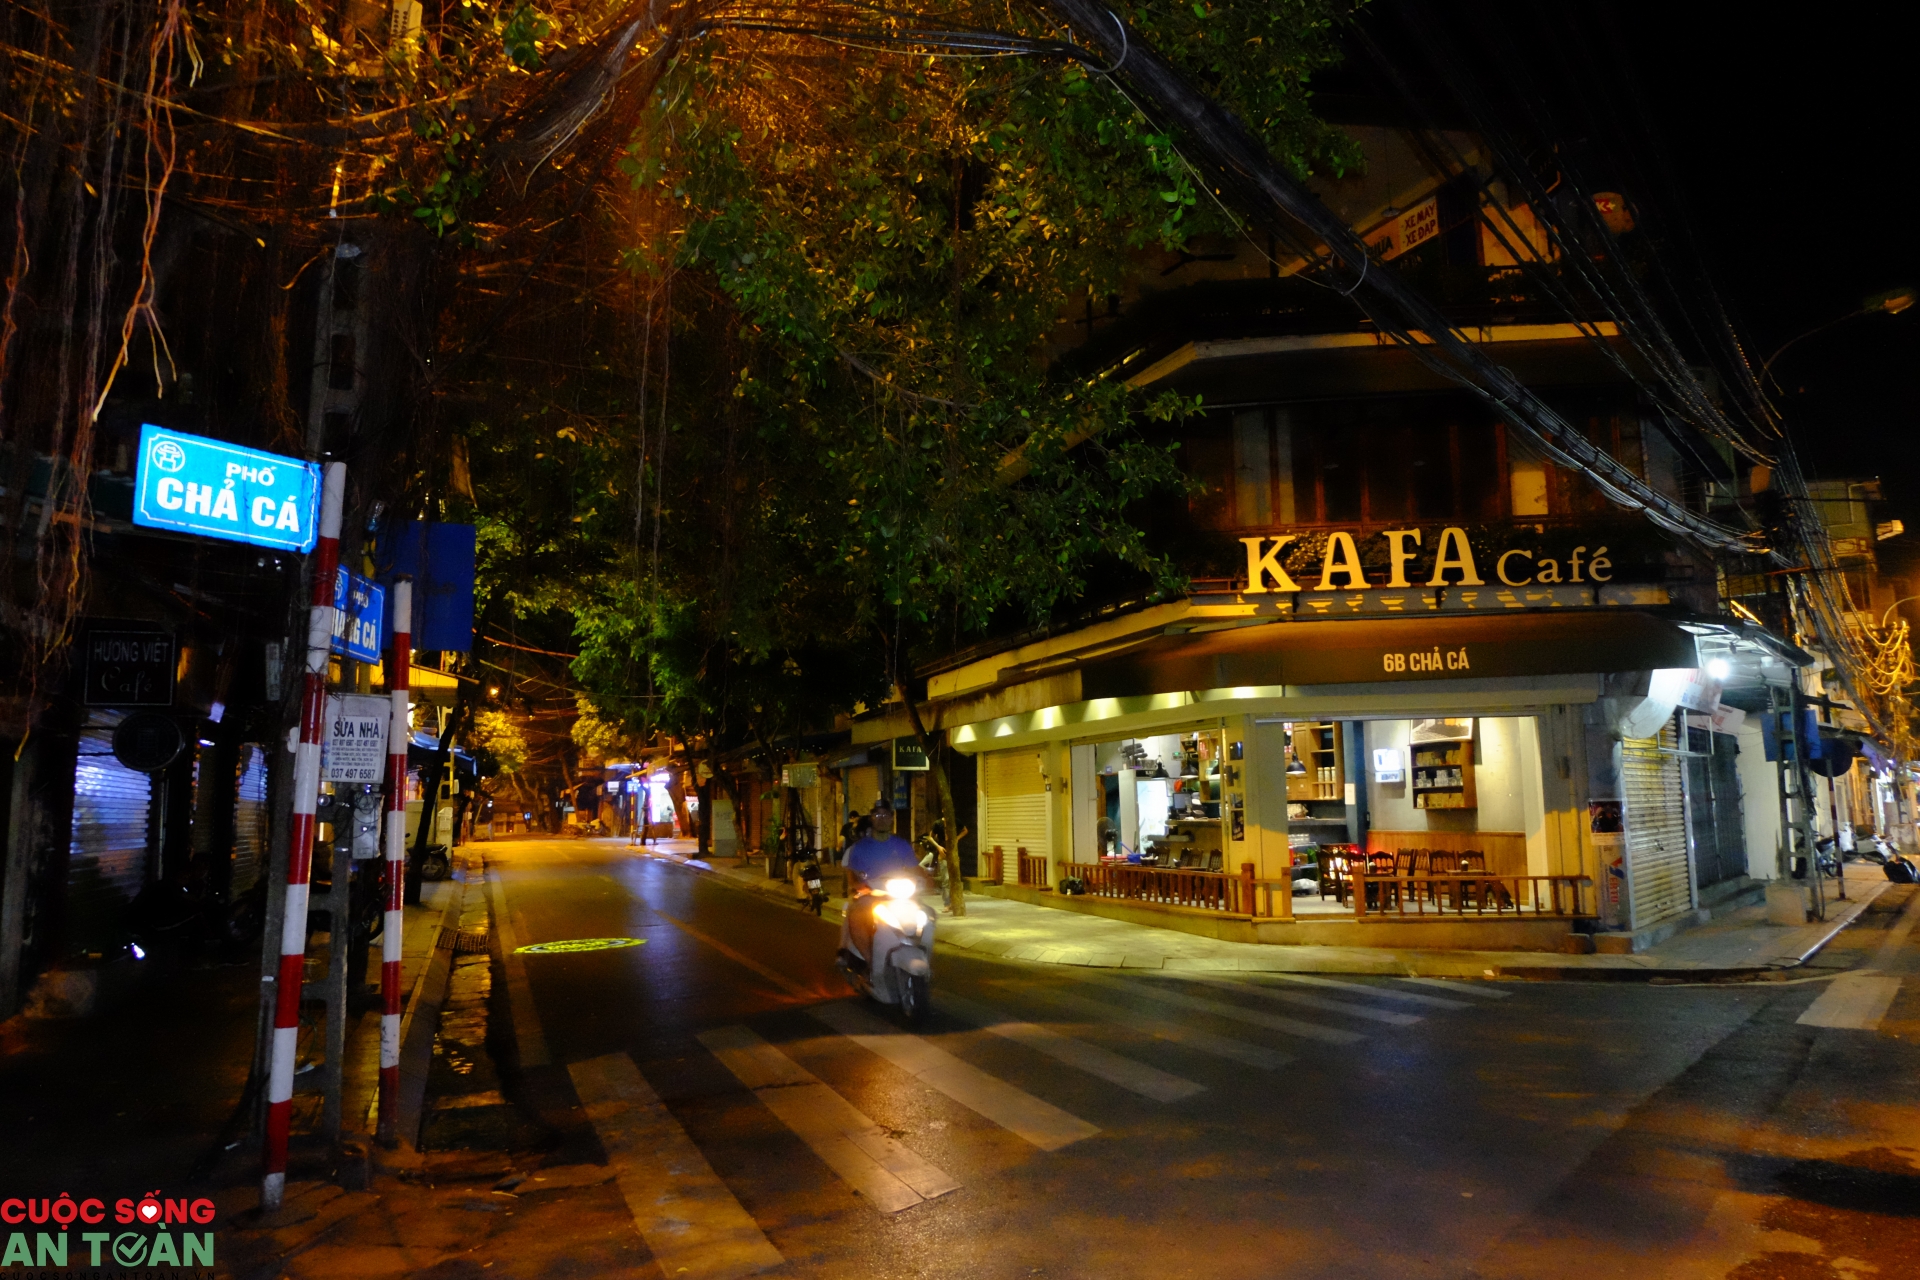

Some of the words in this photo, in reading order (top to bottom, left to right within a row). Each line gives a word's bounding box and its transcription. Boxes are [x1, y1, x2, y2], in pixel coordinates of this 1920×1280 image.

[1405, 215, 1417, 231] XE
[1406, 230, 1417, 247] XE
[225, 462, 277, 486] PHỐ
[156, 477, 238, 521] CHẢ
[251, 495, 300, 533] CÁ
[1238, 526, 1486, 594] KAFA
[1496, 546, 1613, 586] Café
[362, 618, 377, 651] CÁ
[1383, 653, 1406, 672] 6B
[1409, 646, 1444, 671] CHẢ
[1446, 642, 1470, 670] CÁ
[101, 666, 153, 701] Café
[333, 717, 355, 738] SỬA
[359, 718, 379, 738] NHÀ
[899, 745, 922, 753] KAFA
[331, 768, 343, 778] 037
[345, 768, 358, 778] 497
[359, 769, 376, 779] 6587
